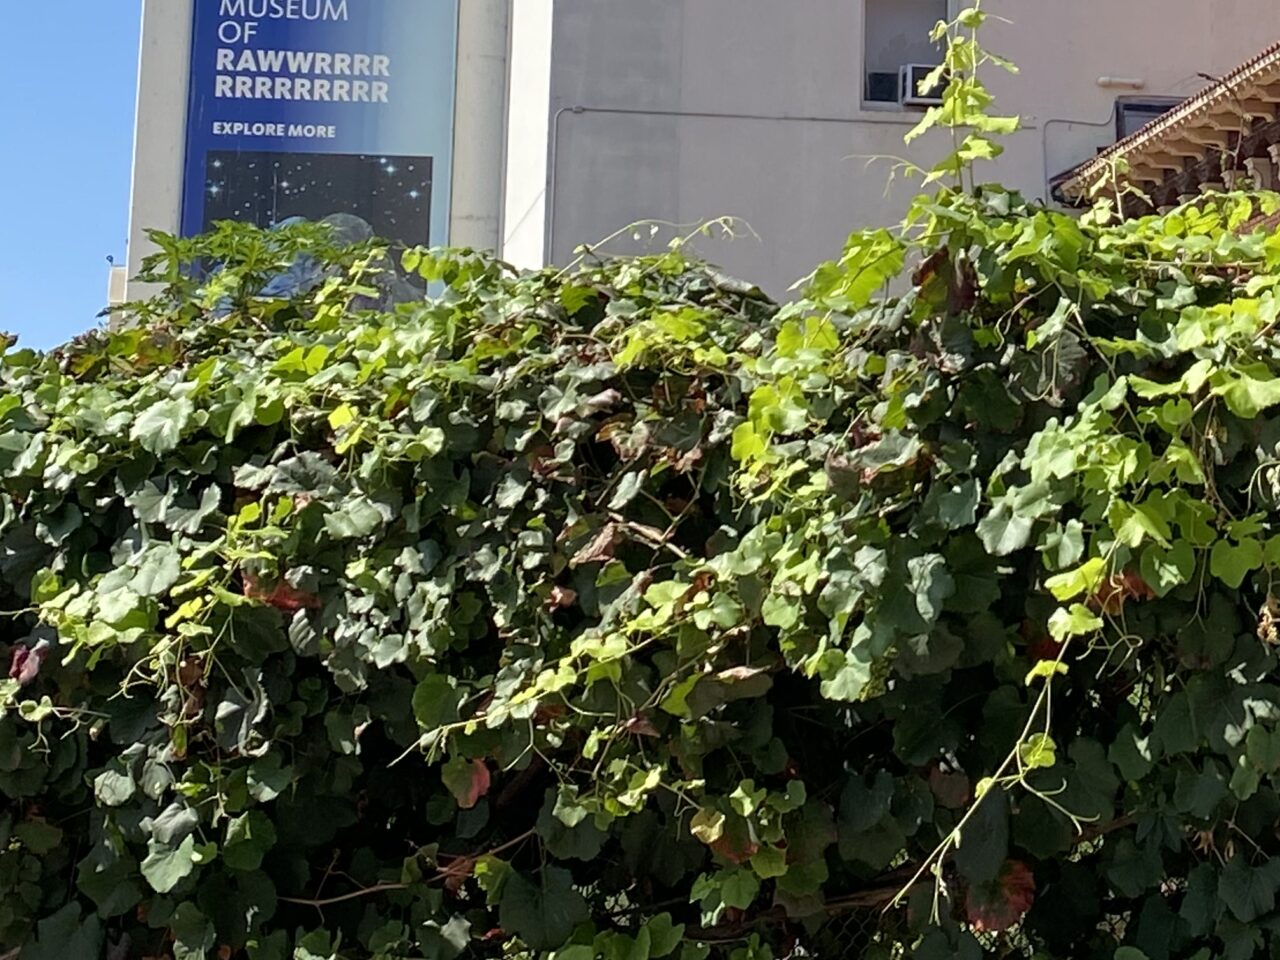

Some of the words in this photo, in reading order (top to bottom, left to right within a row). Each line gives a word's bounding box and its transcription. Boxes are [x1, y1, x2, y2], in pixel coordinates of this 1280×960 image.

[217, 21, 258, 44] OF
[215, 48, 390, 76] RAWWRRRR
[214, 75, 389, 103] RRRRRRRRR
[212, 121, 285, 136] EXPLORE
[288, 124, 337, 138] MORE
